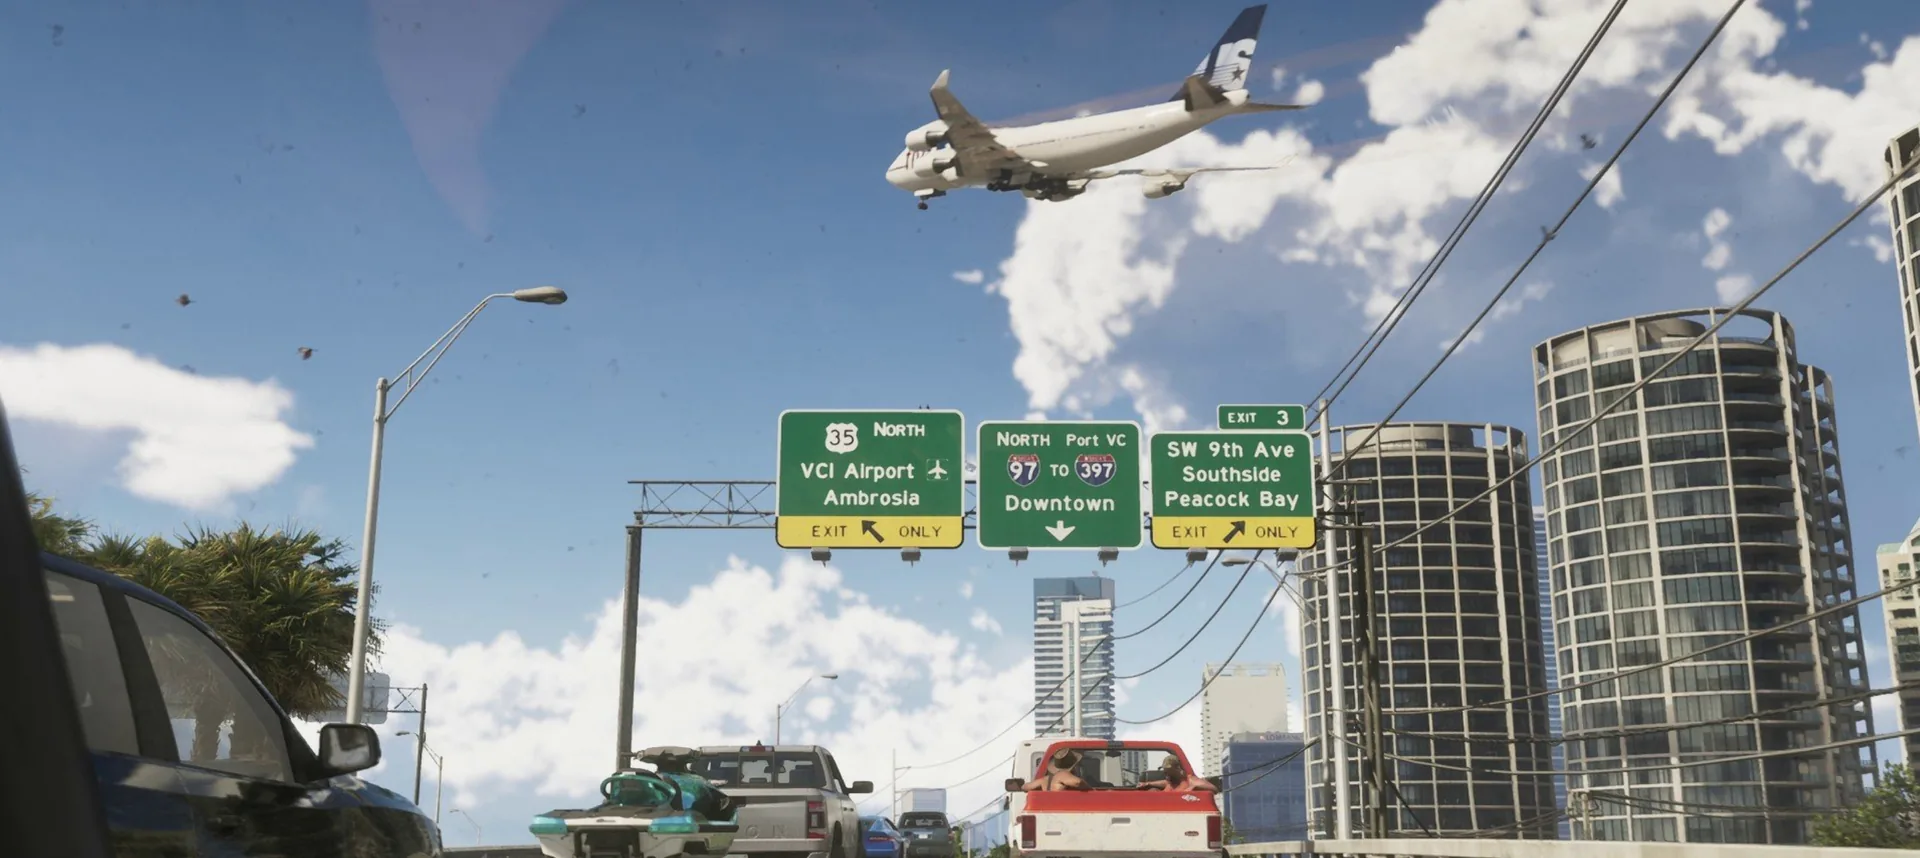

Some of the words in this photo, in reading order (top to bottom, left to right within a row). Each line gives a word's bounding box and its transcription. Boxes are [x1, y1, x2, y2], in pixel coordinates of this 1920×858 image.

[1227, 412, 1257, 424] EXIT
[1276, 411, 1289, 425] 3
[828, 429, 855, 446] 35
[873, 421, 926, 437] NORTH
[996, 431, 1051, 447] NORTH
[1066, 433, 1099, 447] Port
[1106, 434, 1127, 447] VC
[1167, 441, 1198, 458] SW
[1208, 441, 1244, 458] 9th
[1254, 441, 1296, 458] Ave
[800, 462, 834, 479] VCI
[843, 462, 915, 483] Airport
[1009, 461, 1037, 481] 97
[1049, 464, 1070, 477] TO
[1080, 462, 1113, 479] 397
[1182, 465, 1283, 483] Southside
[823, 490, 921, 507] Ambrosia
[1005, 494, 1116, 512] Downtown
[1165, 490, 1250, 507] Peacock
[1259, 490, 1300, 511] Bay
[812, 525, 847, 538] EXIT
[898, 526, 942, 538] ONLY
[1171, 526, 1208, 538] EXIT
[1255, 526, 1298, 538] ONLY
